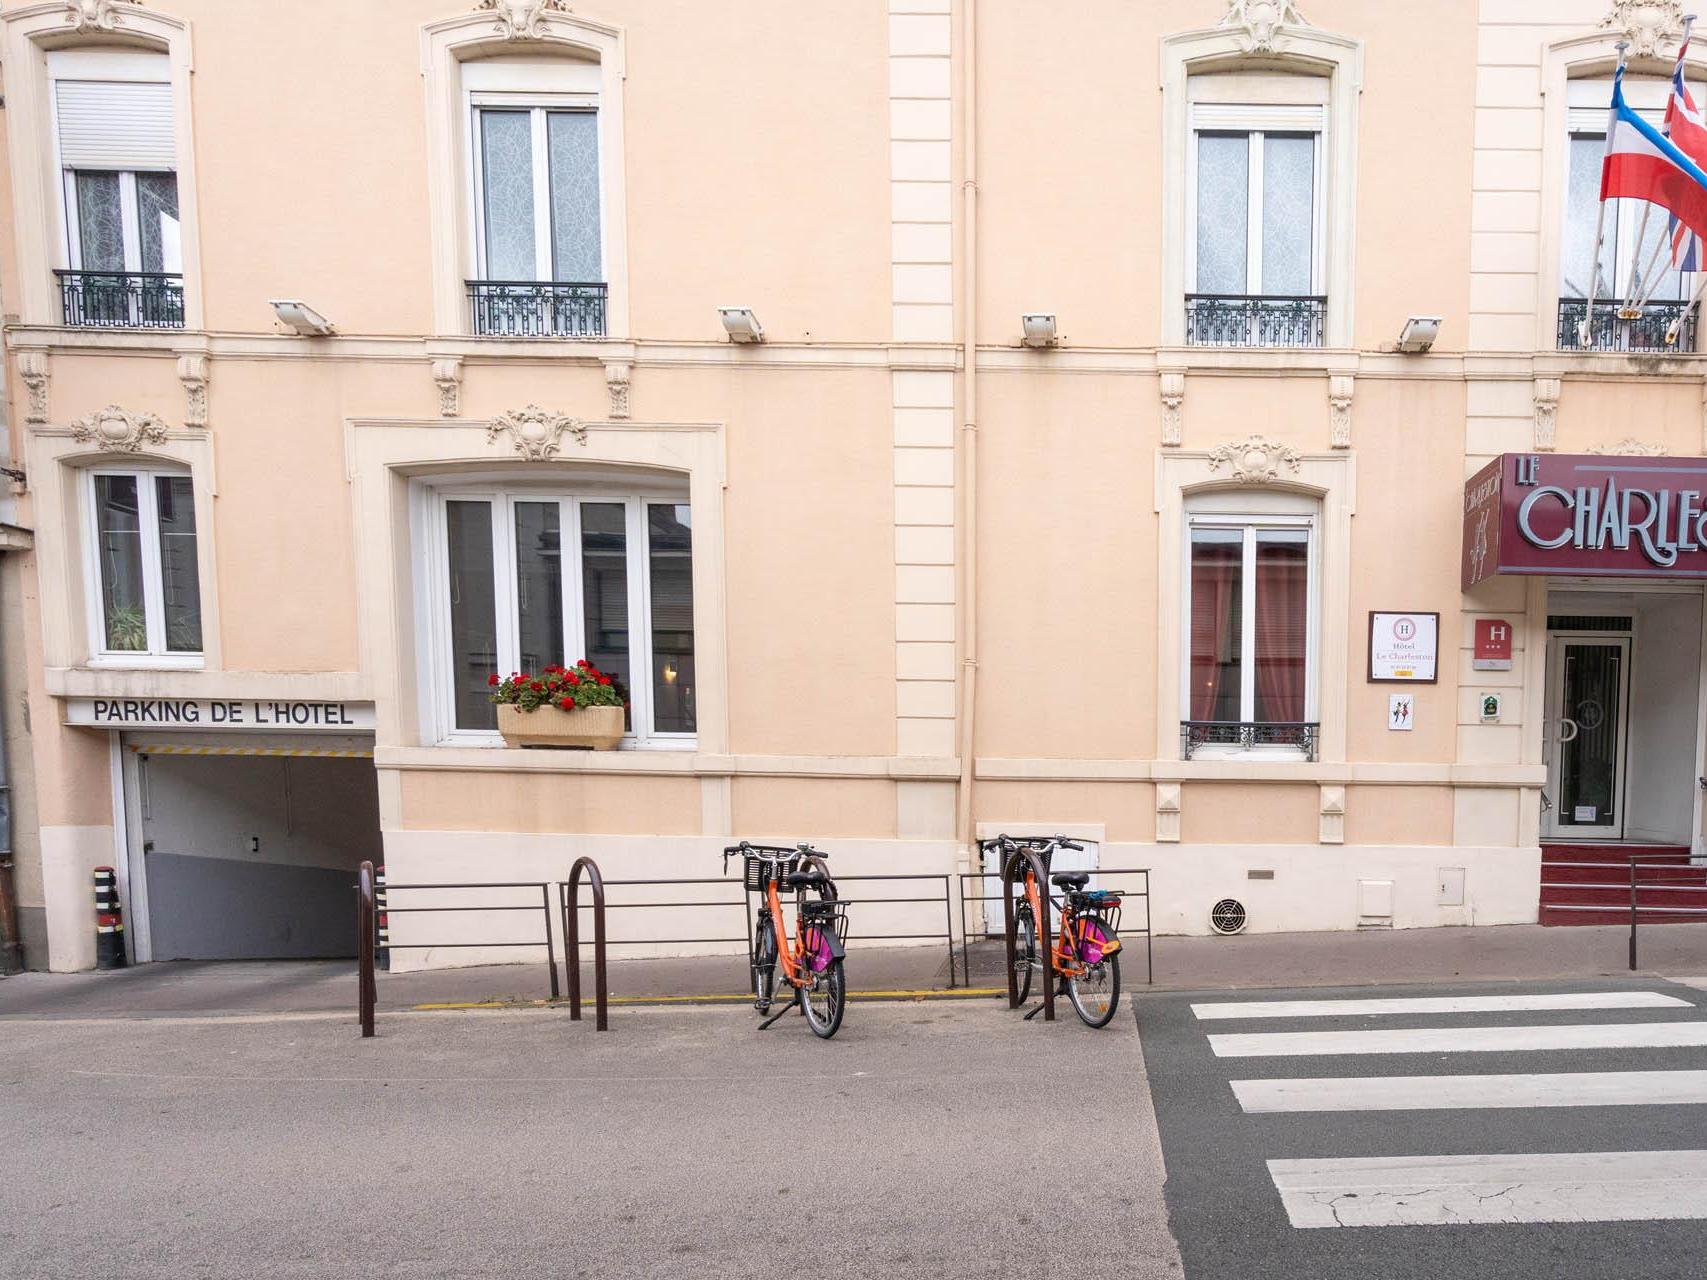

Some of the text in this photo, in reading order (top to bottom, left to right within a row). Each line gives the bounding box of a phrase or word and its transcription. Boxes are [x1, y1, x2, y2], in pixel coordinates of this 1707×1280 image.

[1516, 456, 1539, 486] LE
[1517, 476, 1707, 567] CHARLE
[1400, 625, 1409, 634] H
[1490, 626, 1505, 641] H
[1393, 642, 1415, 650] Hôtel
[94, 700, 354, 725] PARKING DE L'HOTEL
